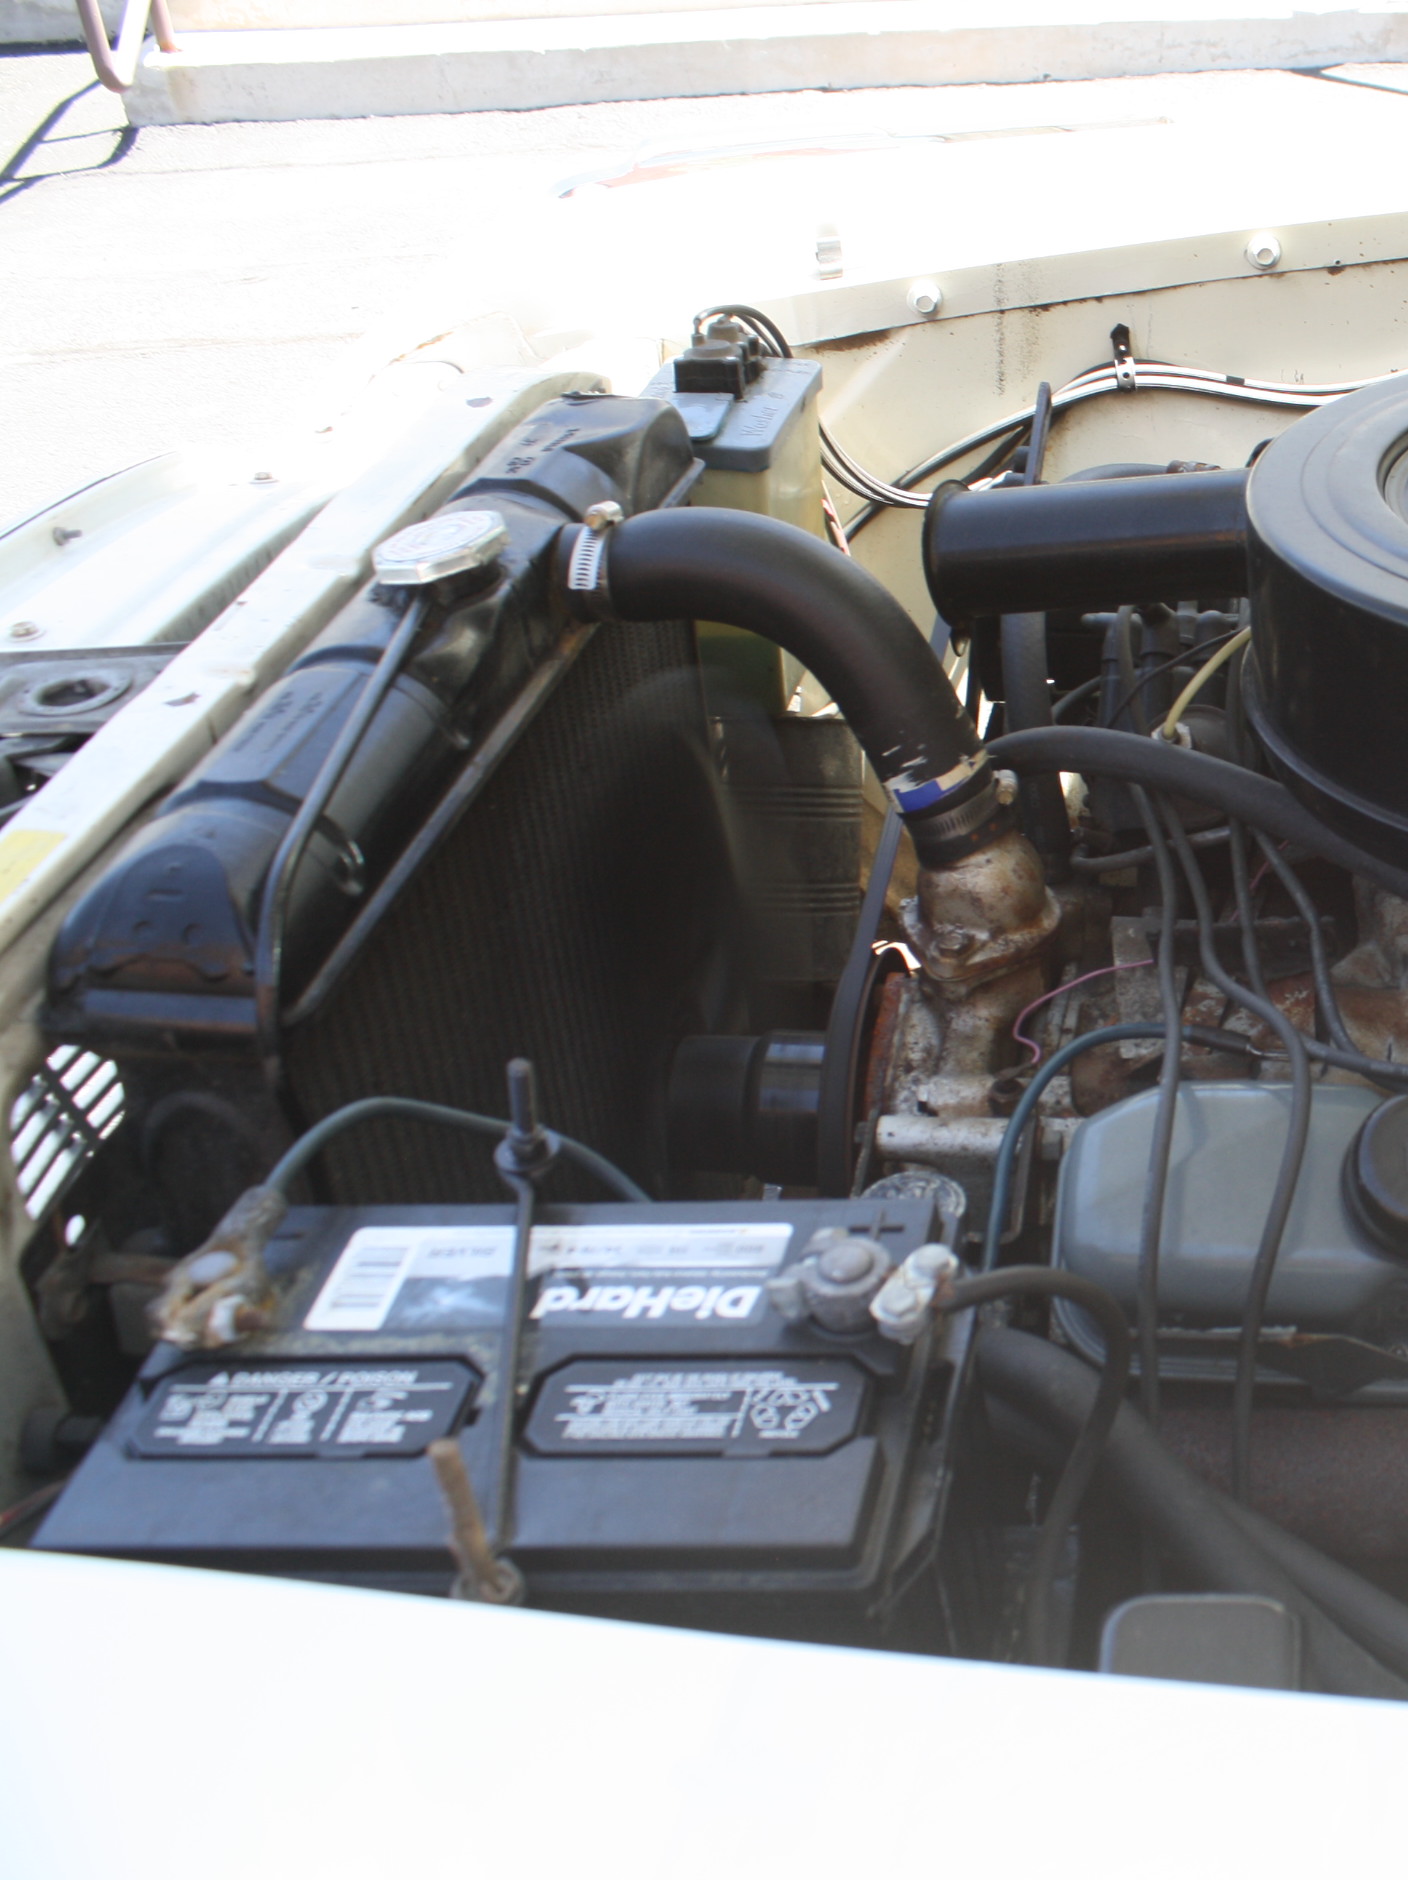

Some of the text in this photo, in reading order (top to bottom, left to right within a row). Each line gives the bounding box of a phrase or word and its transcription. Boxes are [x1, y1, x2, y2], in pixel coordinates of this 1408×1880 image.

[529, 1285, 763, 1320] DieHard
[229, 1371, 320, 1385] DANGER
[337, 1370, 419, 1384] POISON
